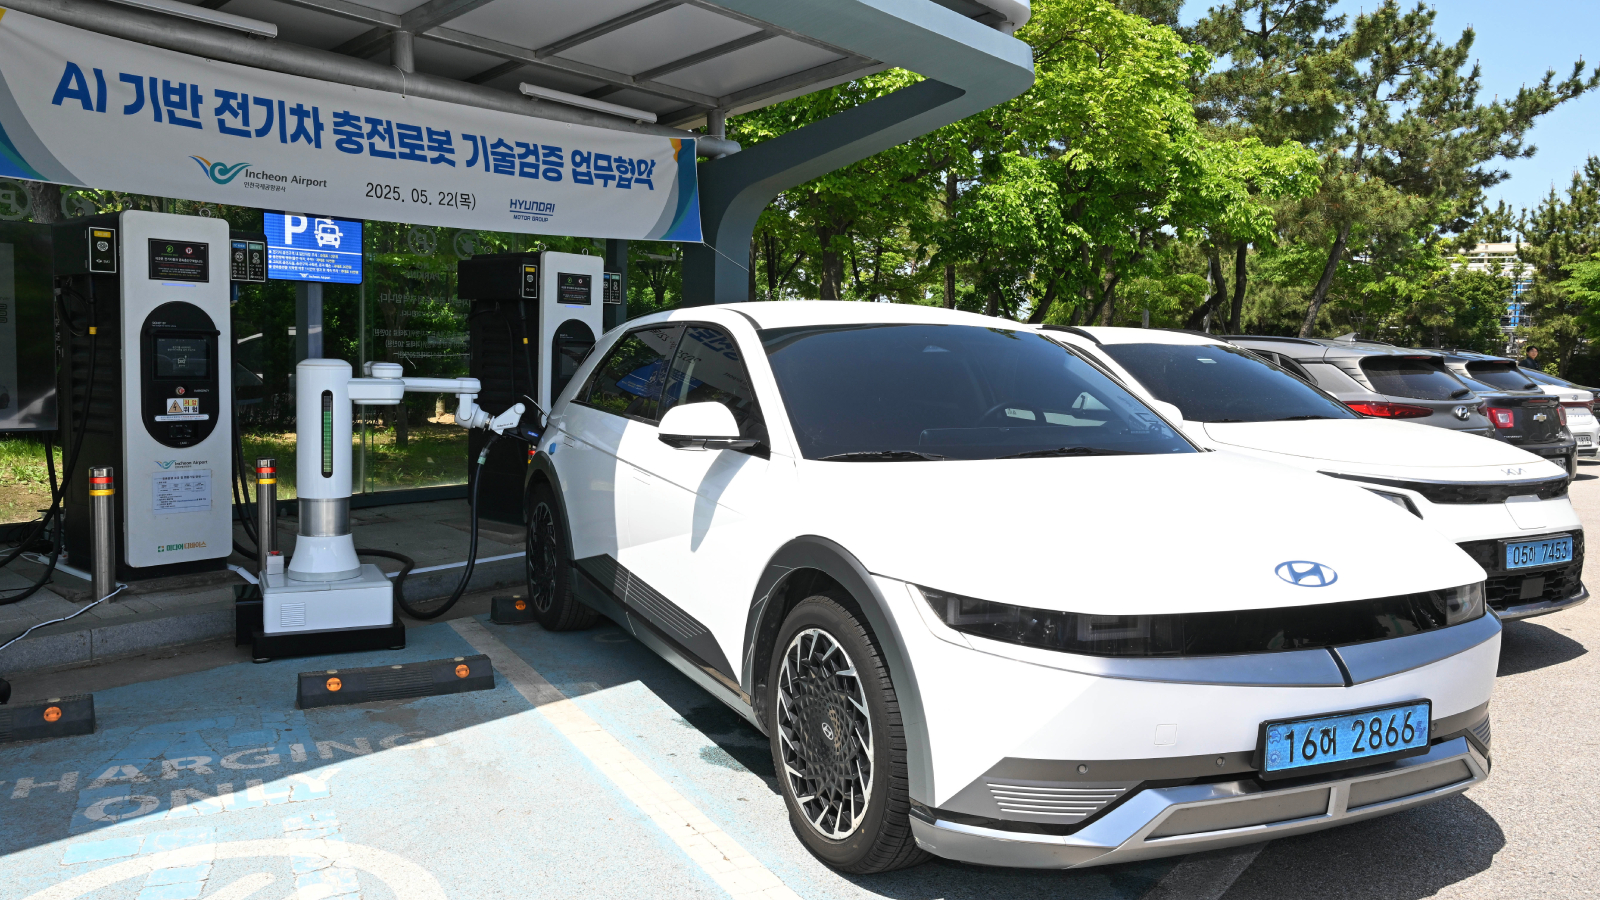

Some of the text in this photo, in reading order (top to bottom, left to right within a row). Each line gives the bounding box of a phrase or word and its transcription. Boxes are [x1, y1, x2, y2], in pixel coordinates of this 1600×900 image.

[51, 61, 658, 191] AI 기반 전기차 충전로봇 기술검증 업무협약
[243, 181, 286, 193] 인천국제공항공사
[244, 168, 328, 188] Incheon Airport
[365, 182, 476, 211] 2025. 05. 22(목)
[510, 198, 556, 213] HYUNDAI
[284, 213, 308, 246] P
[1512, 541, 1568, 565] 05하 7453
[1285, 711, 1415, 763] 16허 2866
[0, 730, 434, 799] HARGING
[83, 767, 343, 823] ONLY
